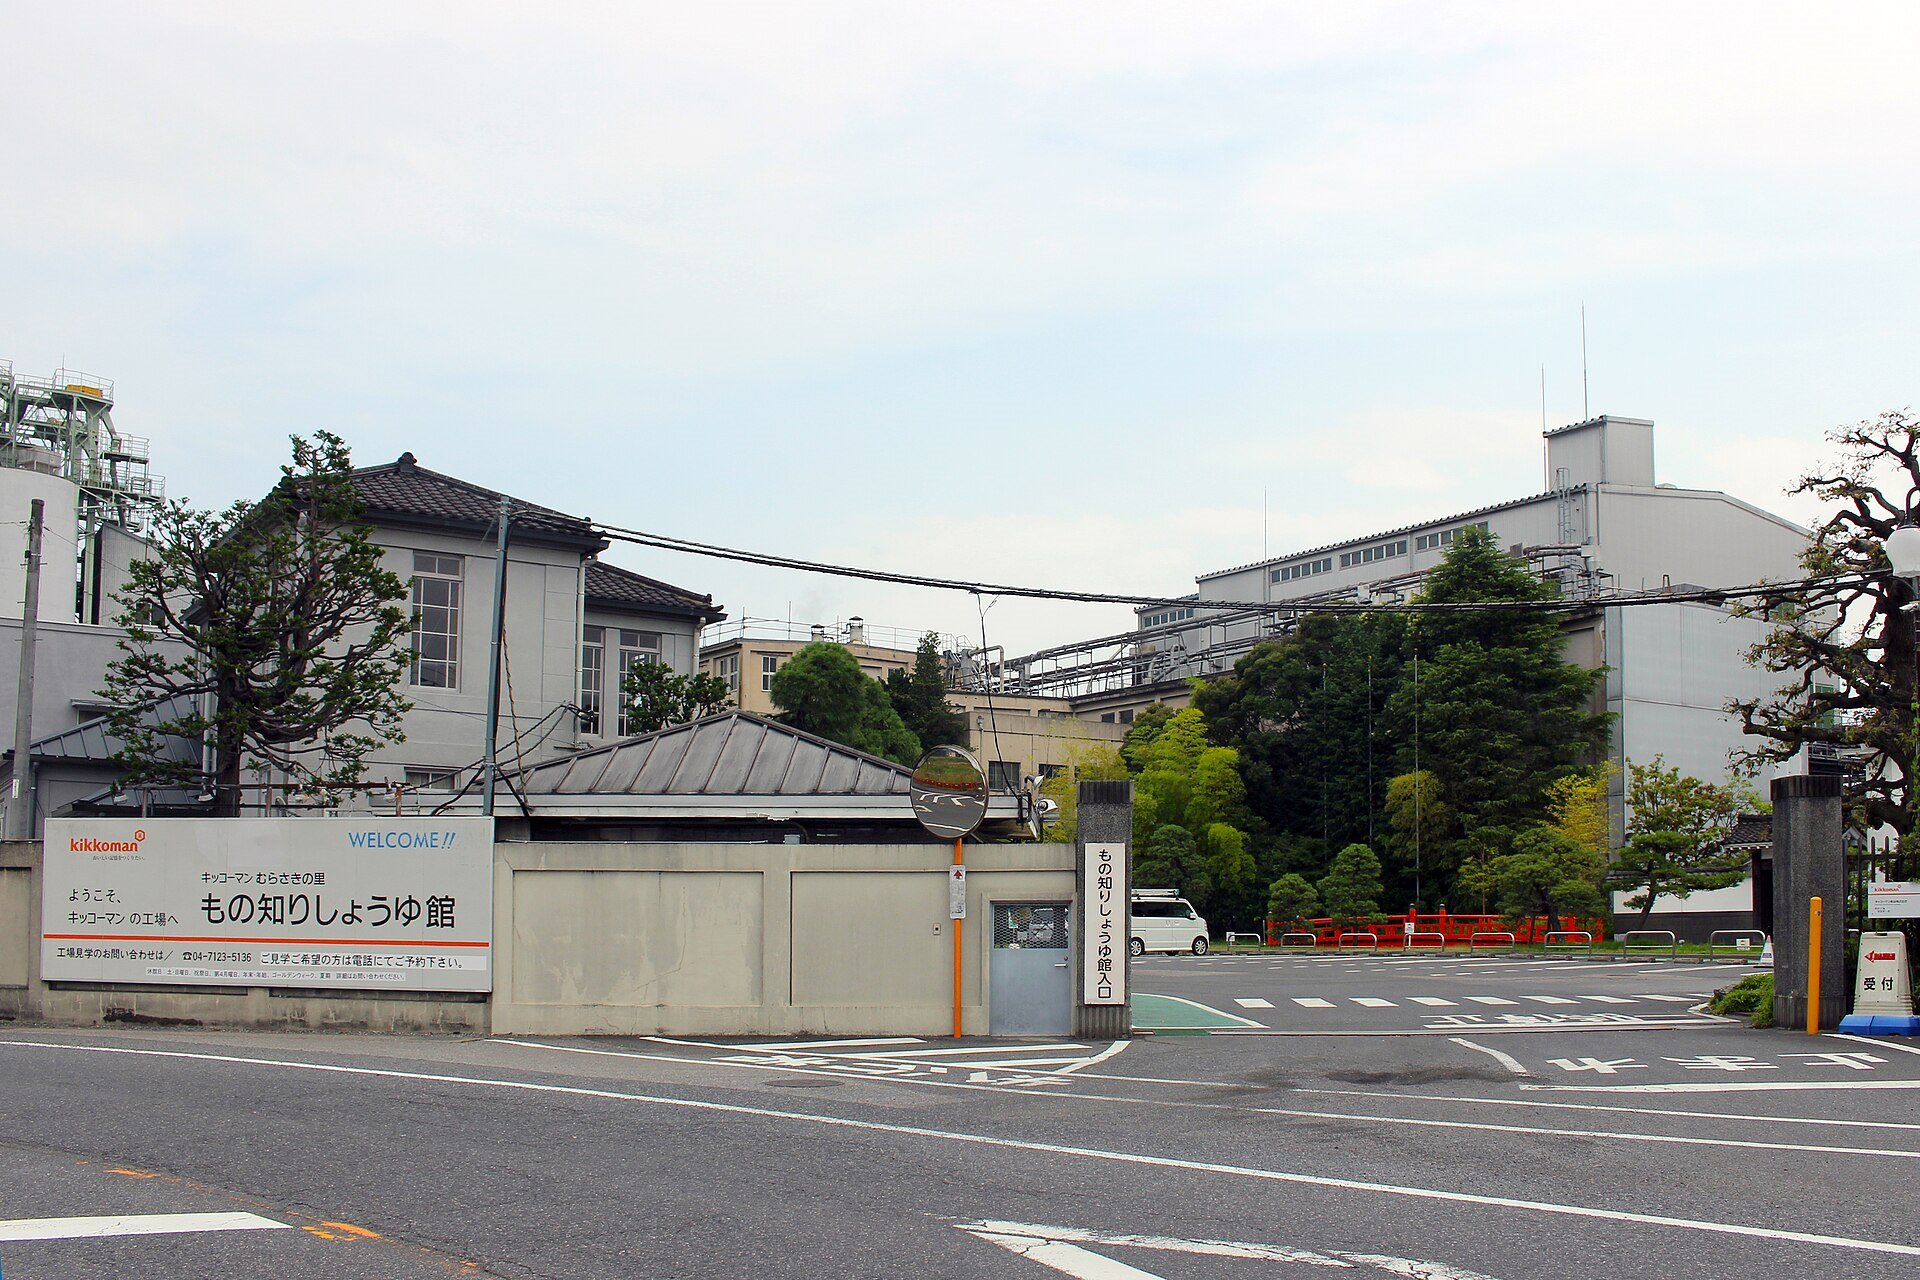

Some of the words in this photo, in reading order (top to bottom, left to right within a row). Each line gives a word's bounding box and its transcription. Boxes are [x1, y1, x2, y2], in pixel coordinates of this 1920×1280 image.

[70, 837, 139, 853] kikkoman
[349, 832, 457, 850] WELCOME!!
[201, 871, 253, 884] キッコーマン
[256, 871, 326, 886] むらさきの里
[68, 888, 121, 904] ようこそ、
[200, 892, 456, 929] もの知りしょうゆ館
[68, 911, 125, 925] キッコーマン
[129, 912, 179, 927] の工場へ
[1097, 848, 1113, 999] もの知りしょうゆ館入口
[261, 952, 464, 969] ご見学ご希望の方は電話にてご予約下さい。
[1863, 976, 1894, 991] 受付
